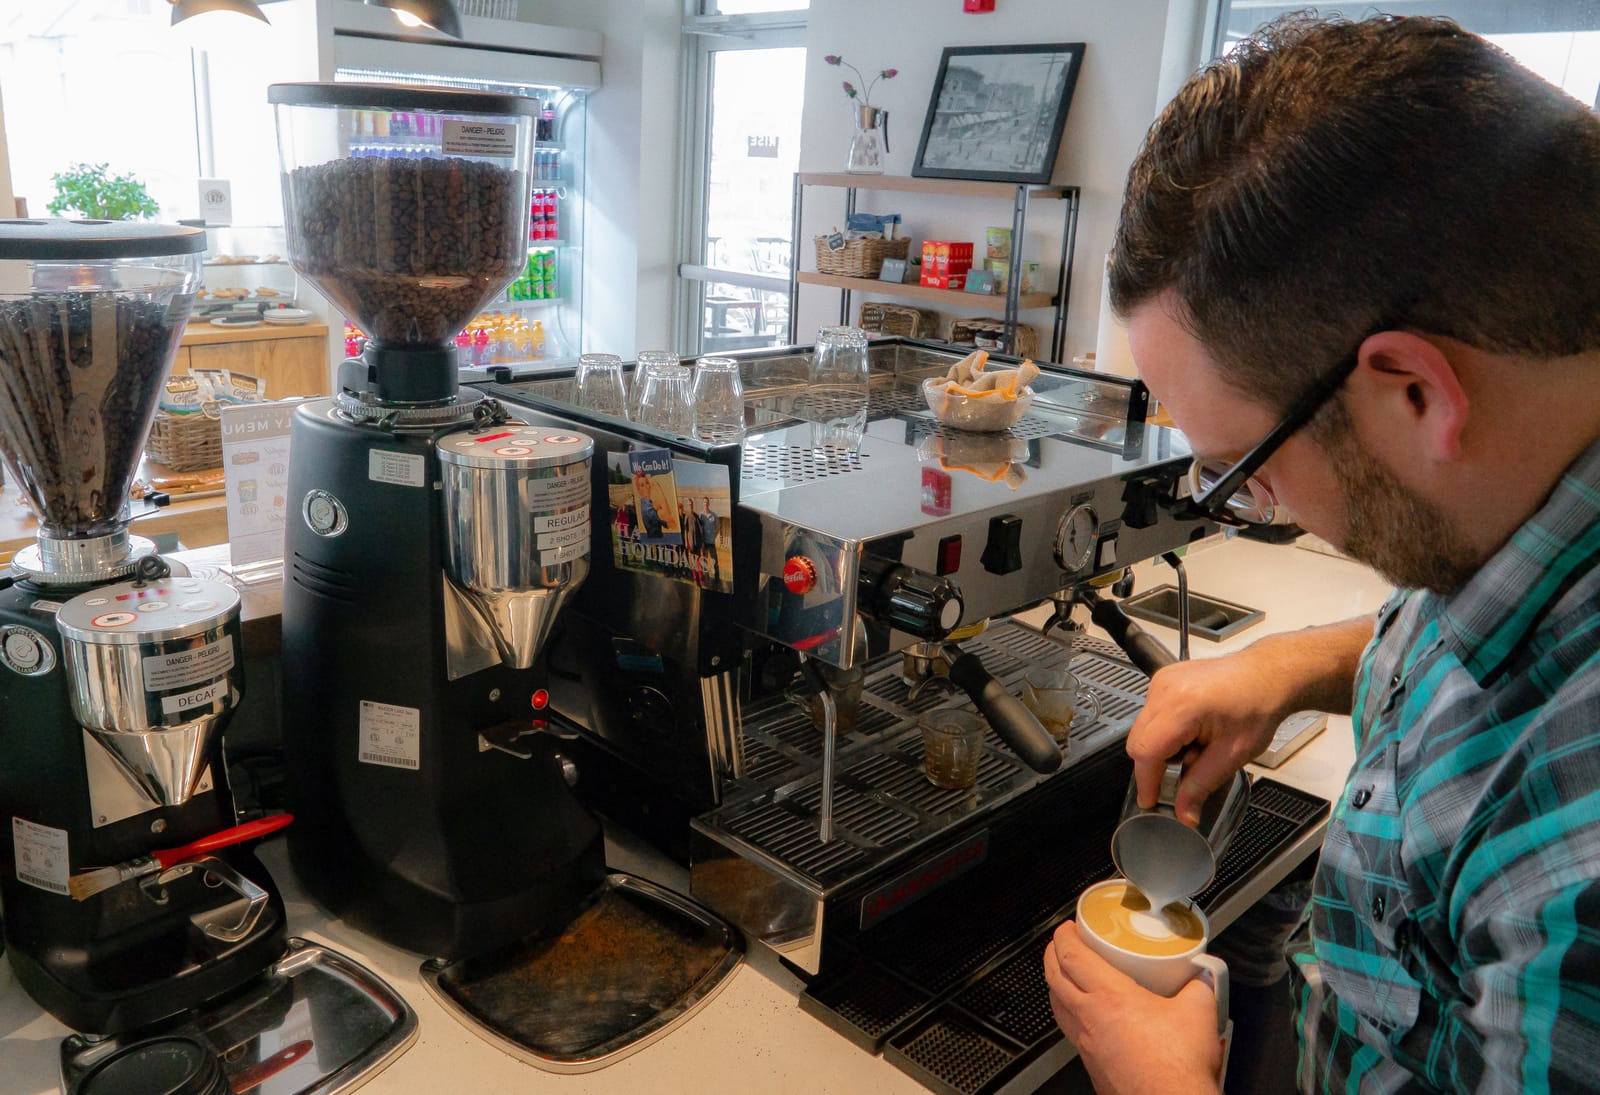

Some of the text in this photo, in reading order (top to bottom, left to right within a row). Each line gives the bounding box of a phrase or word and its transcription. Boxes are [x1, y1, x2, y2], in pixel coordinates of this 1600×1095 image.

[461, 125, 482, 134] DANGER
[641, 460, 653, 471] Can
[652, 460, 661, 470] Do
[547, 510, 586, 529] REGULAR
[166, 654, 193, 667] DANGER
[178, 687, 217, 708] DECAF
